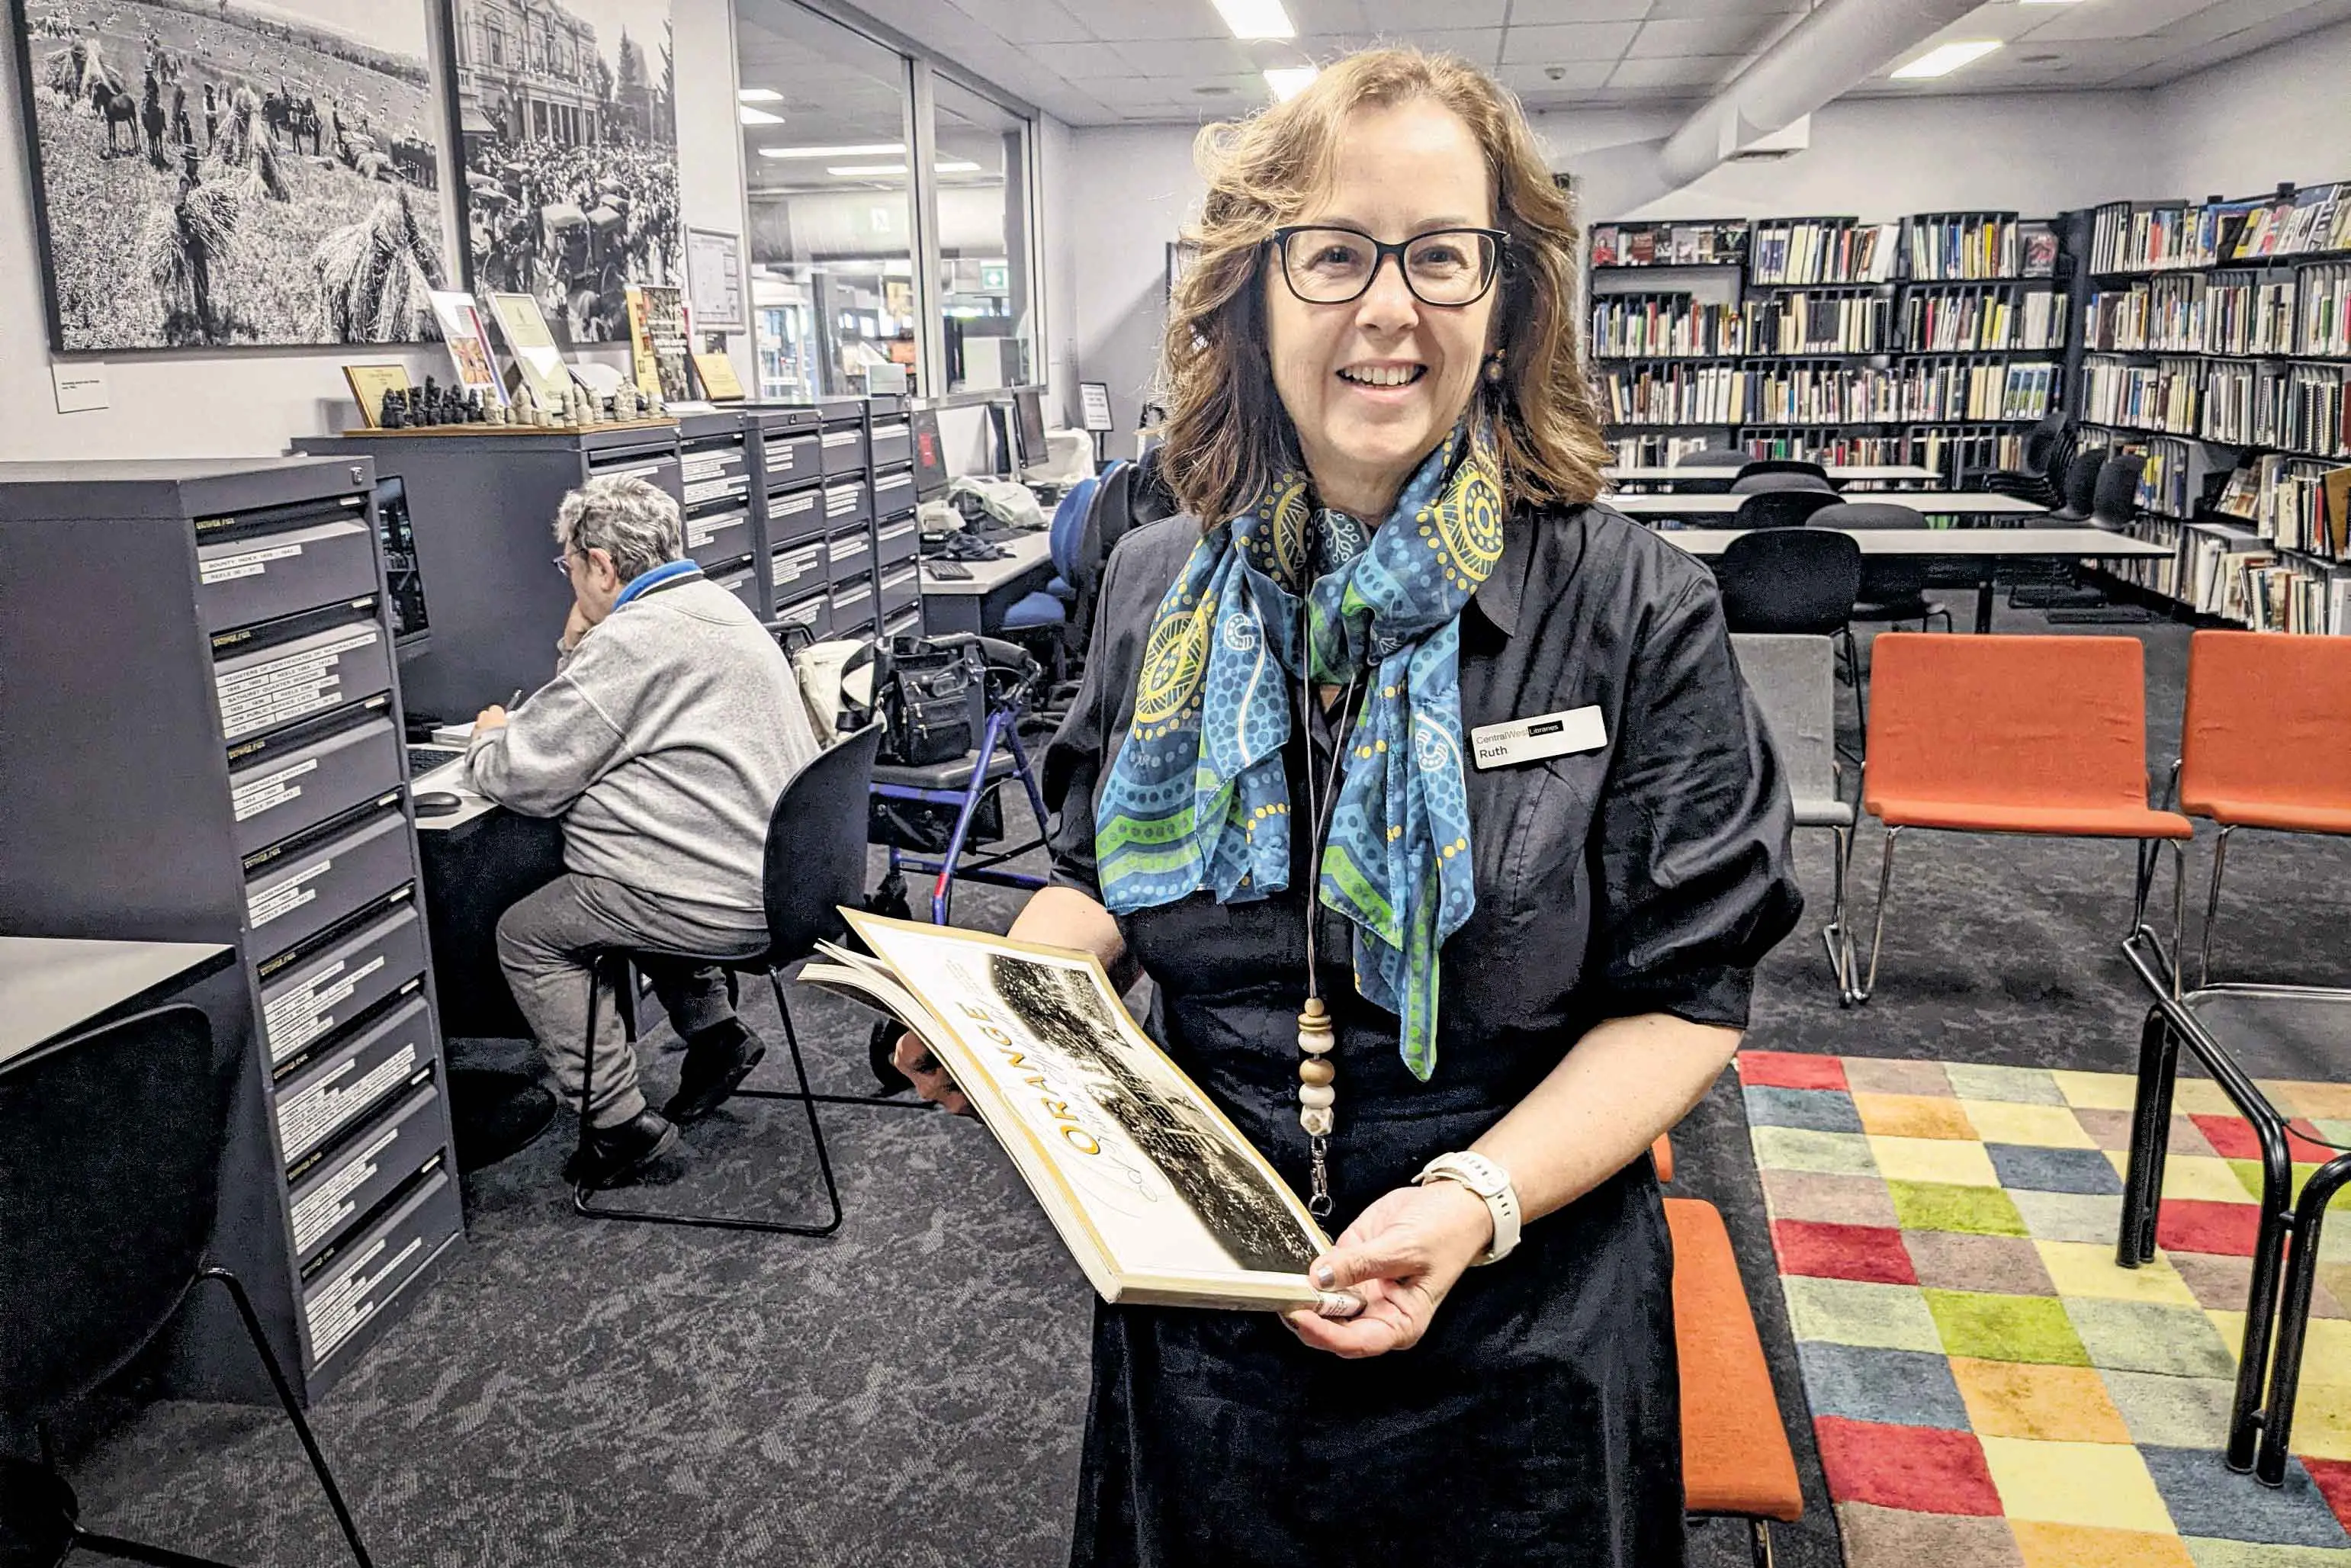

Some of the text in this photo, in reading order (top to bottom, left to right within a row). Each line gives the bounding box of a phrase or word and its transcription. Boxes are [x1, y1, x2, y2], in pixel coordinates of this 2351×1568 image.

[1528, 724, 1559, 735] Libraries
[1479, 745, 1508, 759] Ruth
[955, 1001, 1100, 1155] ORANGE
